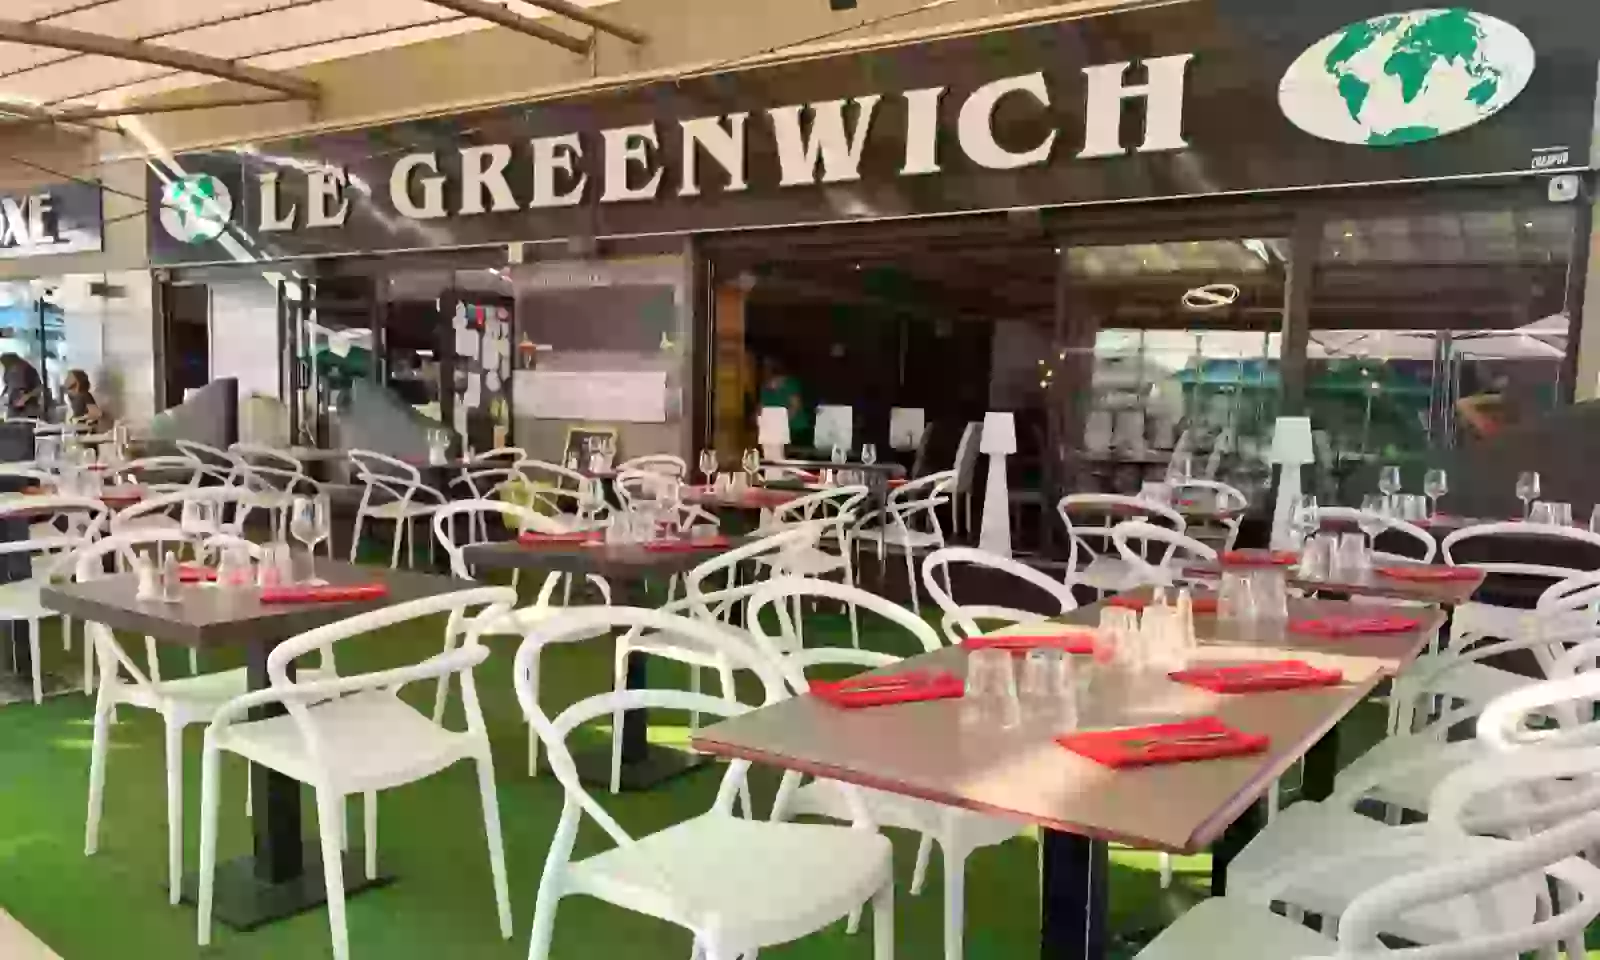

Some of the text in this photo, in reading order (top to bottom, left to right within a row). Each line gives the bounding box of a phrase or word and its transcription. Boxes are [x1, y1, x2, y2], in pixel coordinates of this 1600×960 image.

[258, 53, 1194, 232] LE GREENWICH
[0, 190, 54, 246] XE
